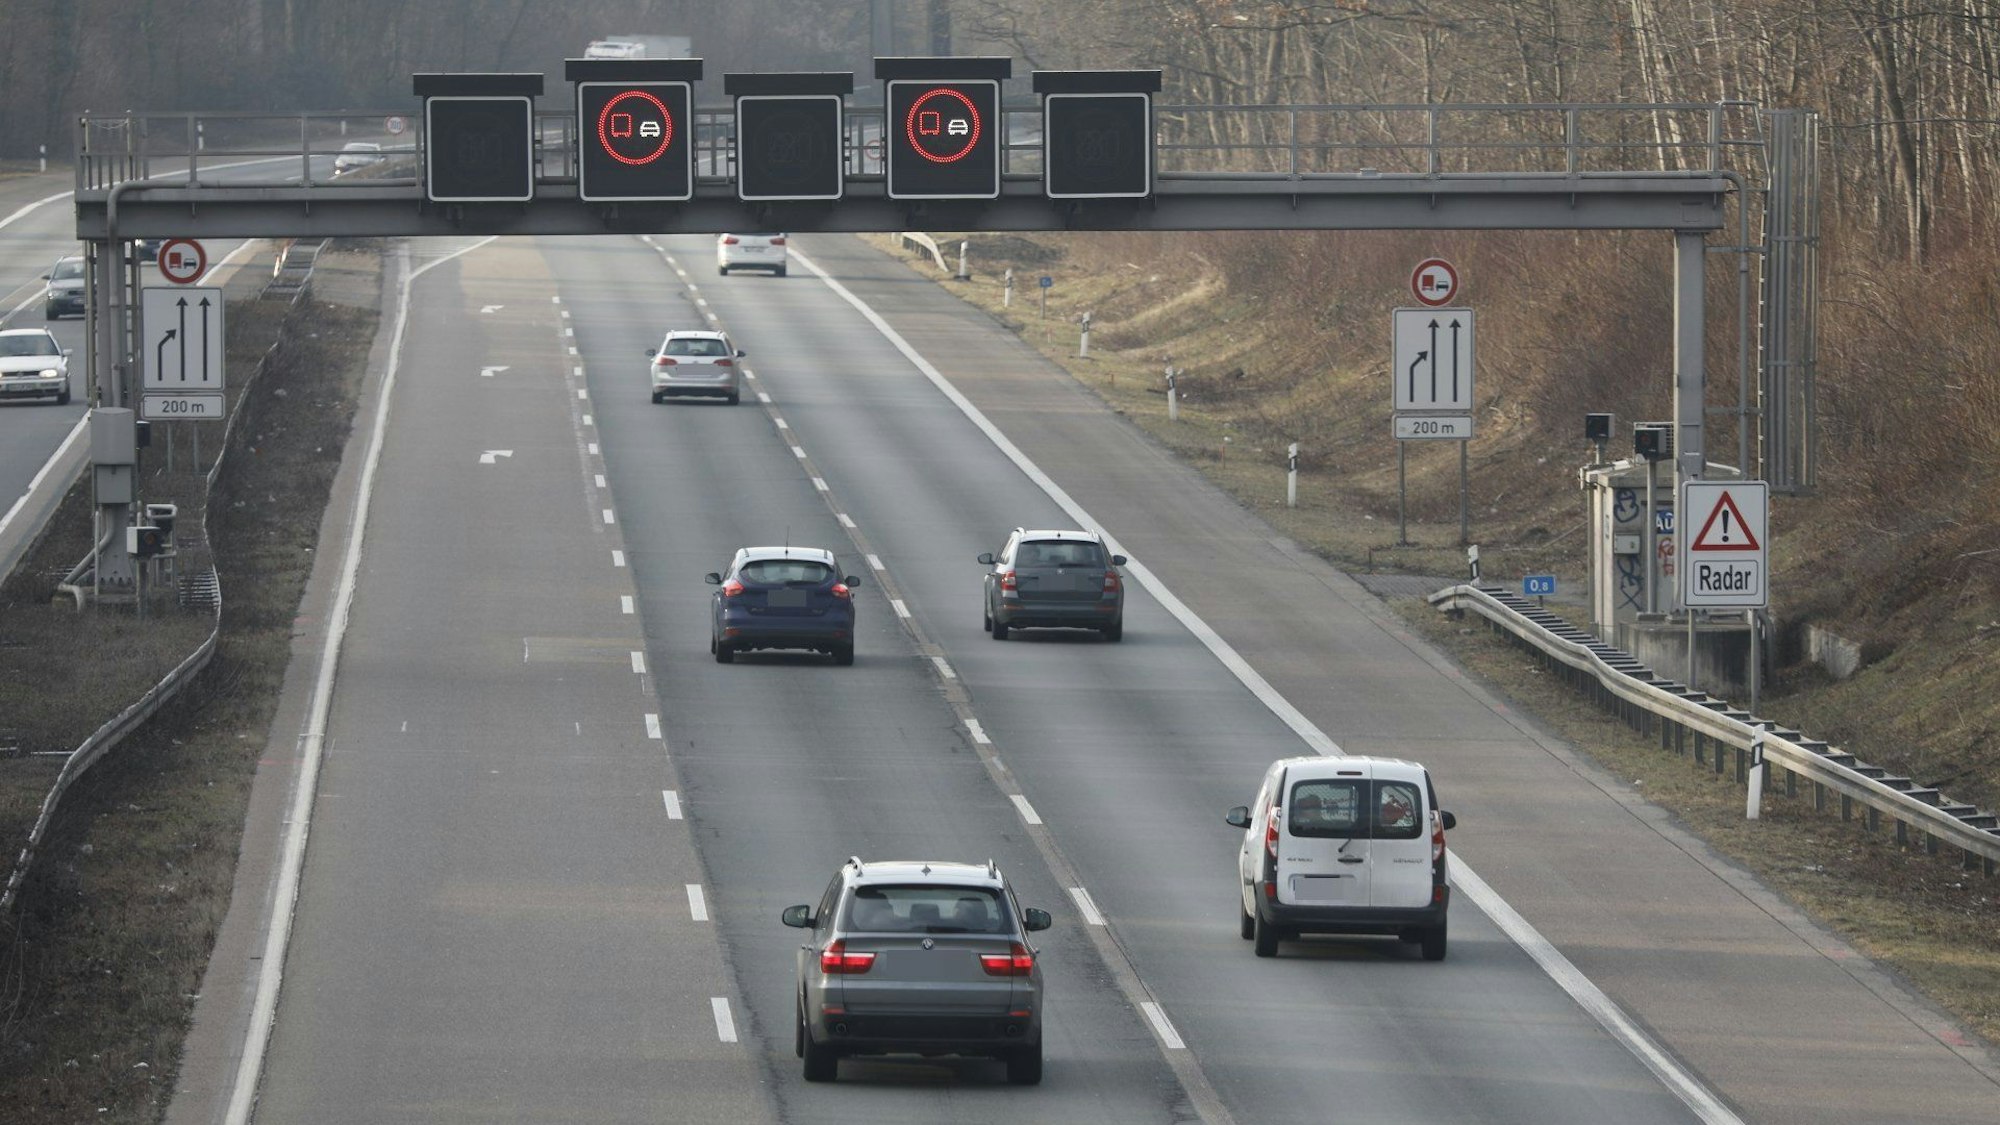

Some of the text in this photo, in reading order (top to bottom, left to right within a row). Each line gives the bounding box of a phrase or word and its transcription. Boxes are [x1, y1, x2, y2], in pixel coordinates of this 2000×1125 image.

[162, 400, 204, 413] 200 m
[1413, 421, 1454, 434] 200 m
[1699, 564, 1751, 591] Radar
